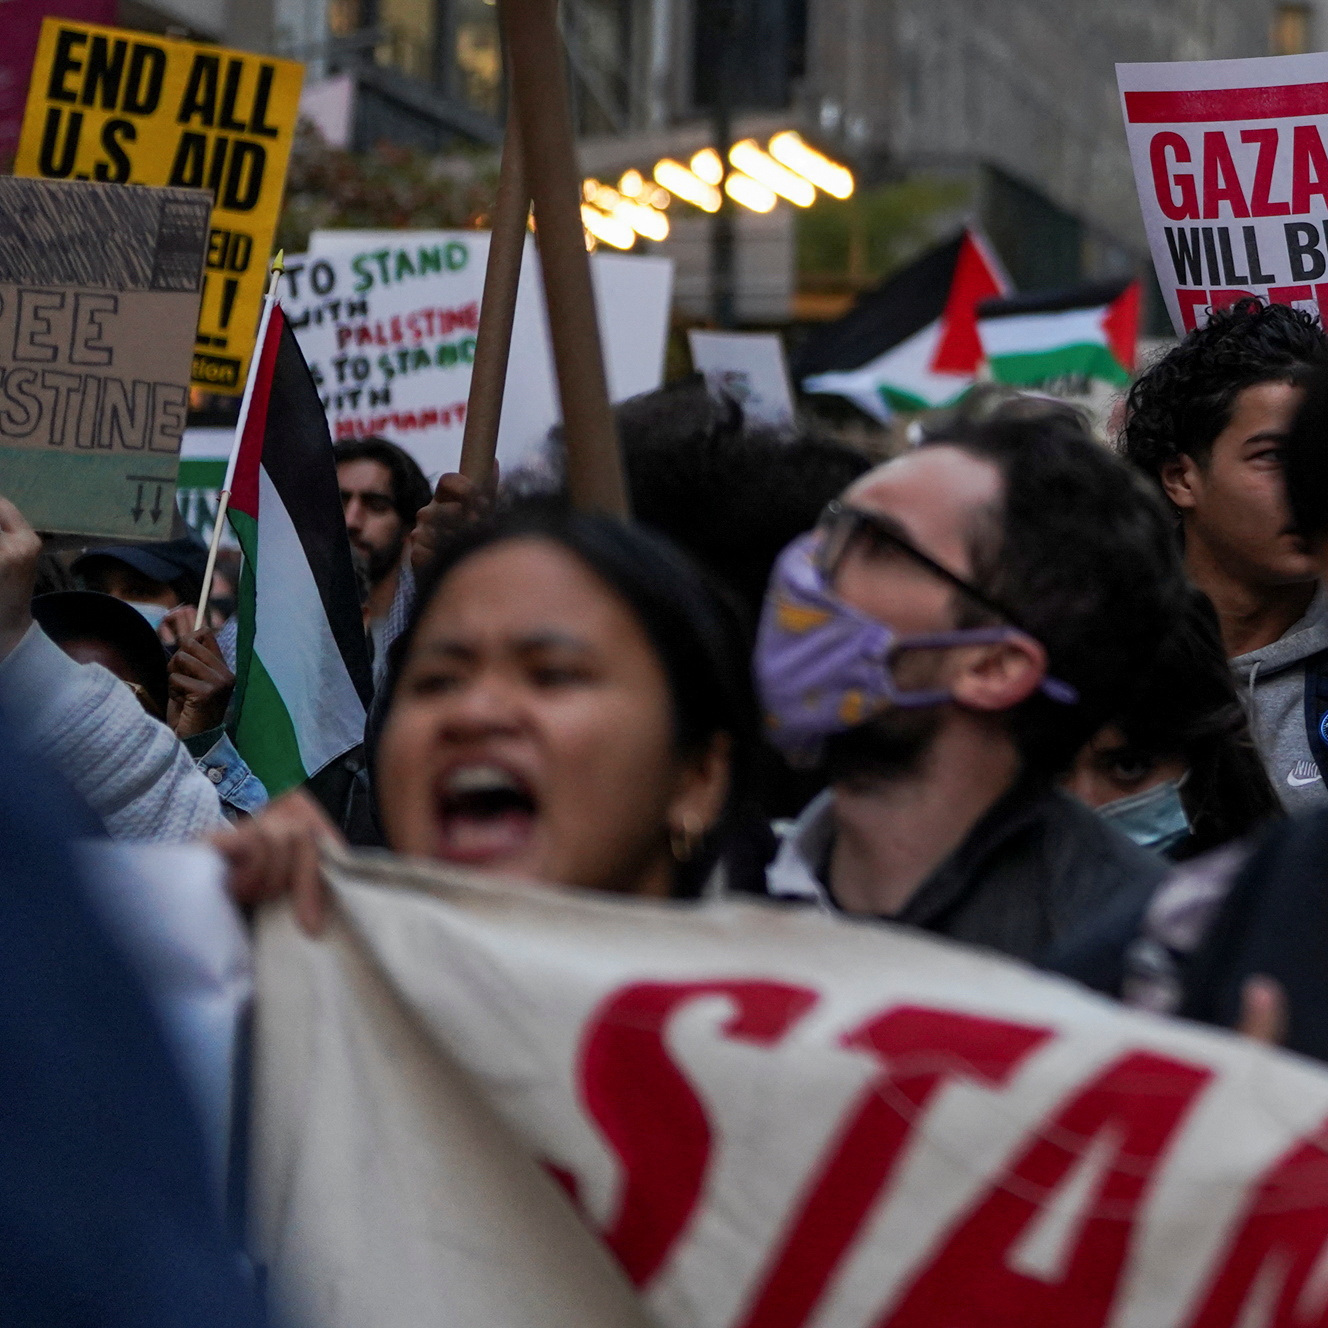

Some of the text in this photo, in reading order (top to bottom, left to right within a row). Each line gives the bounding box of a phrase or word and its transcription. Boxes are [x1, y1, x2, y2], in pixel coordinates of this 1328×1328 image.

[47, 28, 279, 139] END ALL
[38, 107, 267, 212] U.S AID
[285, 240, 469, 299] TO STAND
[1164, 225, 1276, 286] WILL
[0, 287, 119, 367] EE
[336, 300, 479, 350] PALESTINE
[332, 354, 371, 383] TO
[0, 366, 190, 454] STINE
[334, 403, 468, 439] HUMANIT
